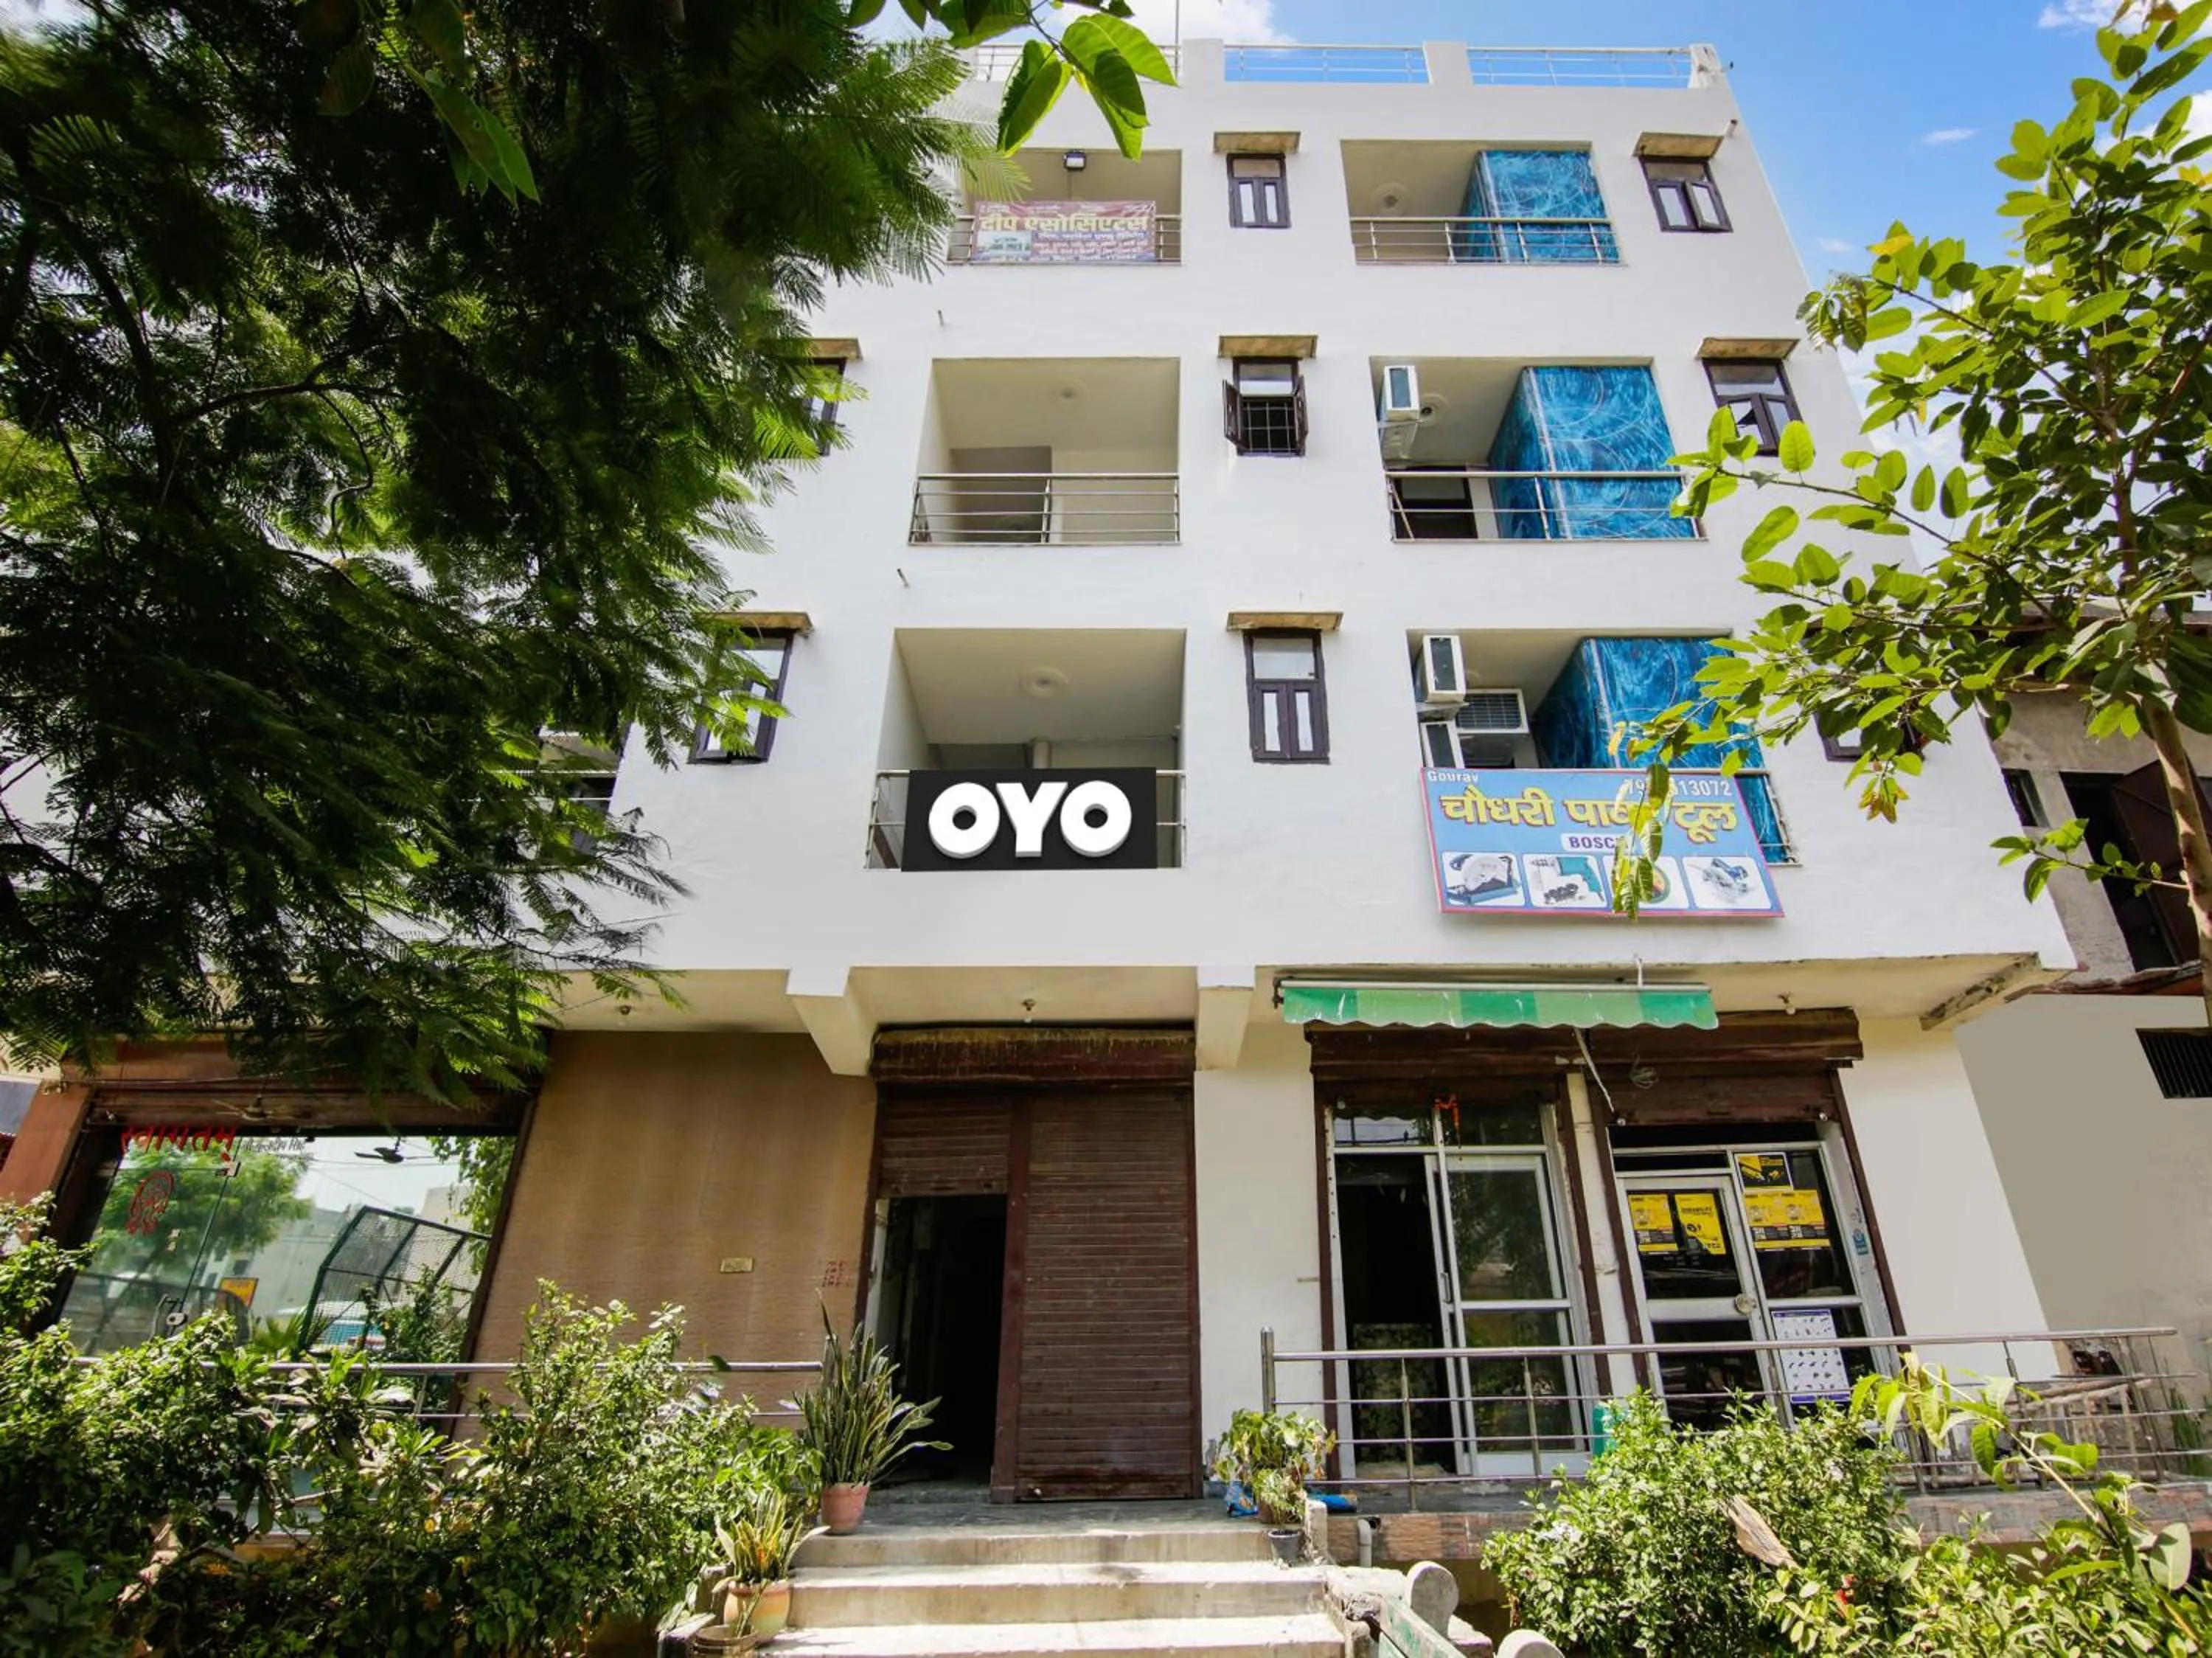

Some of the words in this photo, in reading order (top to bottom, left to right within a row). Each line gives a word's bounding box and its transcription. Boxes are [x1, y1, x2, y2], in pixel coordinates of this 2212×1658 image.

[1427, 770, 1478, 783] Gourav
[928, 780, 1132, 859] OYO
[1439, 784, 1555, 827] चौधरी
[1672, 802, 1737, 843] टूल
[1568, 836, 1630, 850] BOSC
